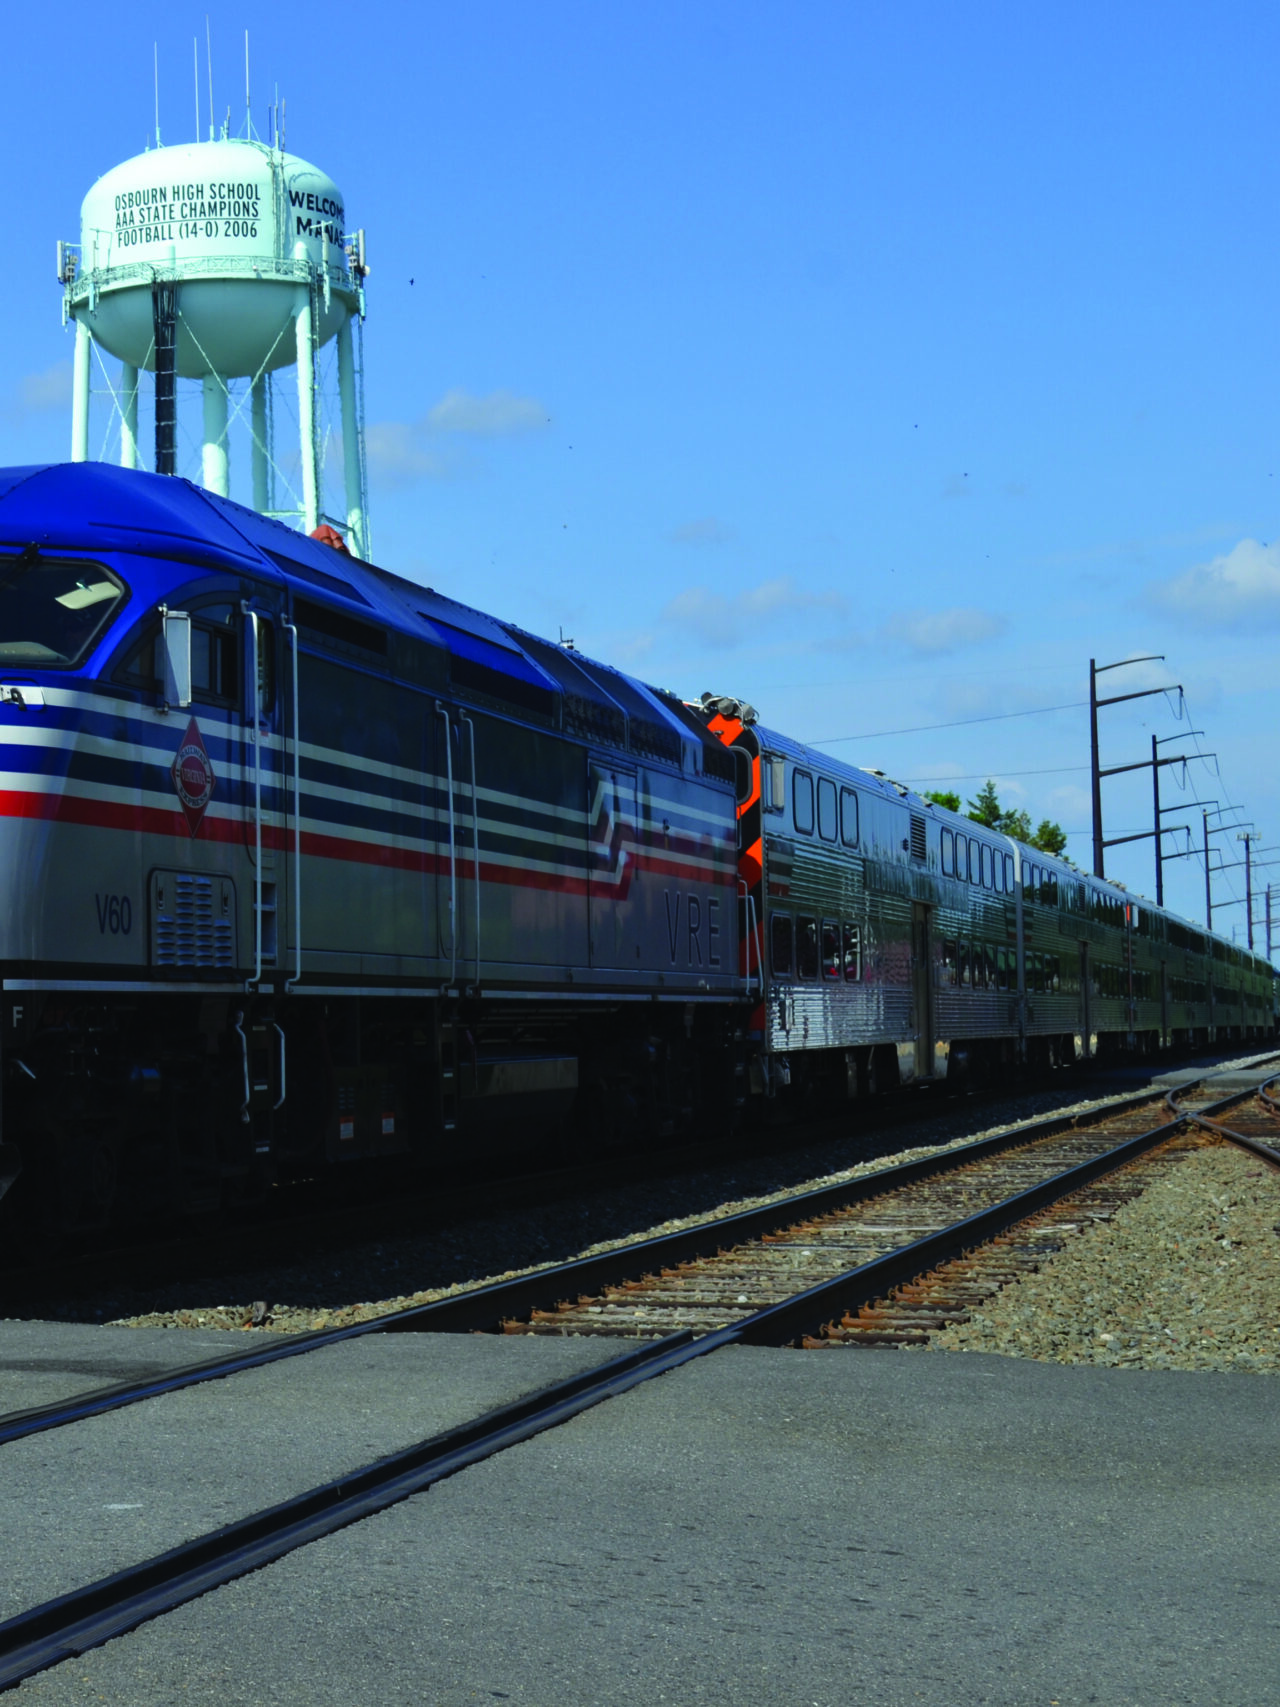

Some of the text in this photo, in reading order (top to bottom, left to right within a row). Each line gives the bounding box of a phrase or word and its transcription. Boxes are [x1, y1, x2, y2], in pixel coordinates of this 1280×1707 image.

[115, 183, 261, 211] OSBOURN HIGH SCHOOL
[115, 201, 259, 229] AAA STATE CHAMPIONS
[117, 220, 258, 248] FOOTBALL (14-0) 2006
[95, 893, 132, 935] V60
[663, 888, 721, 969] VRE
[13, 1005, 24, 1028] F
